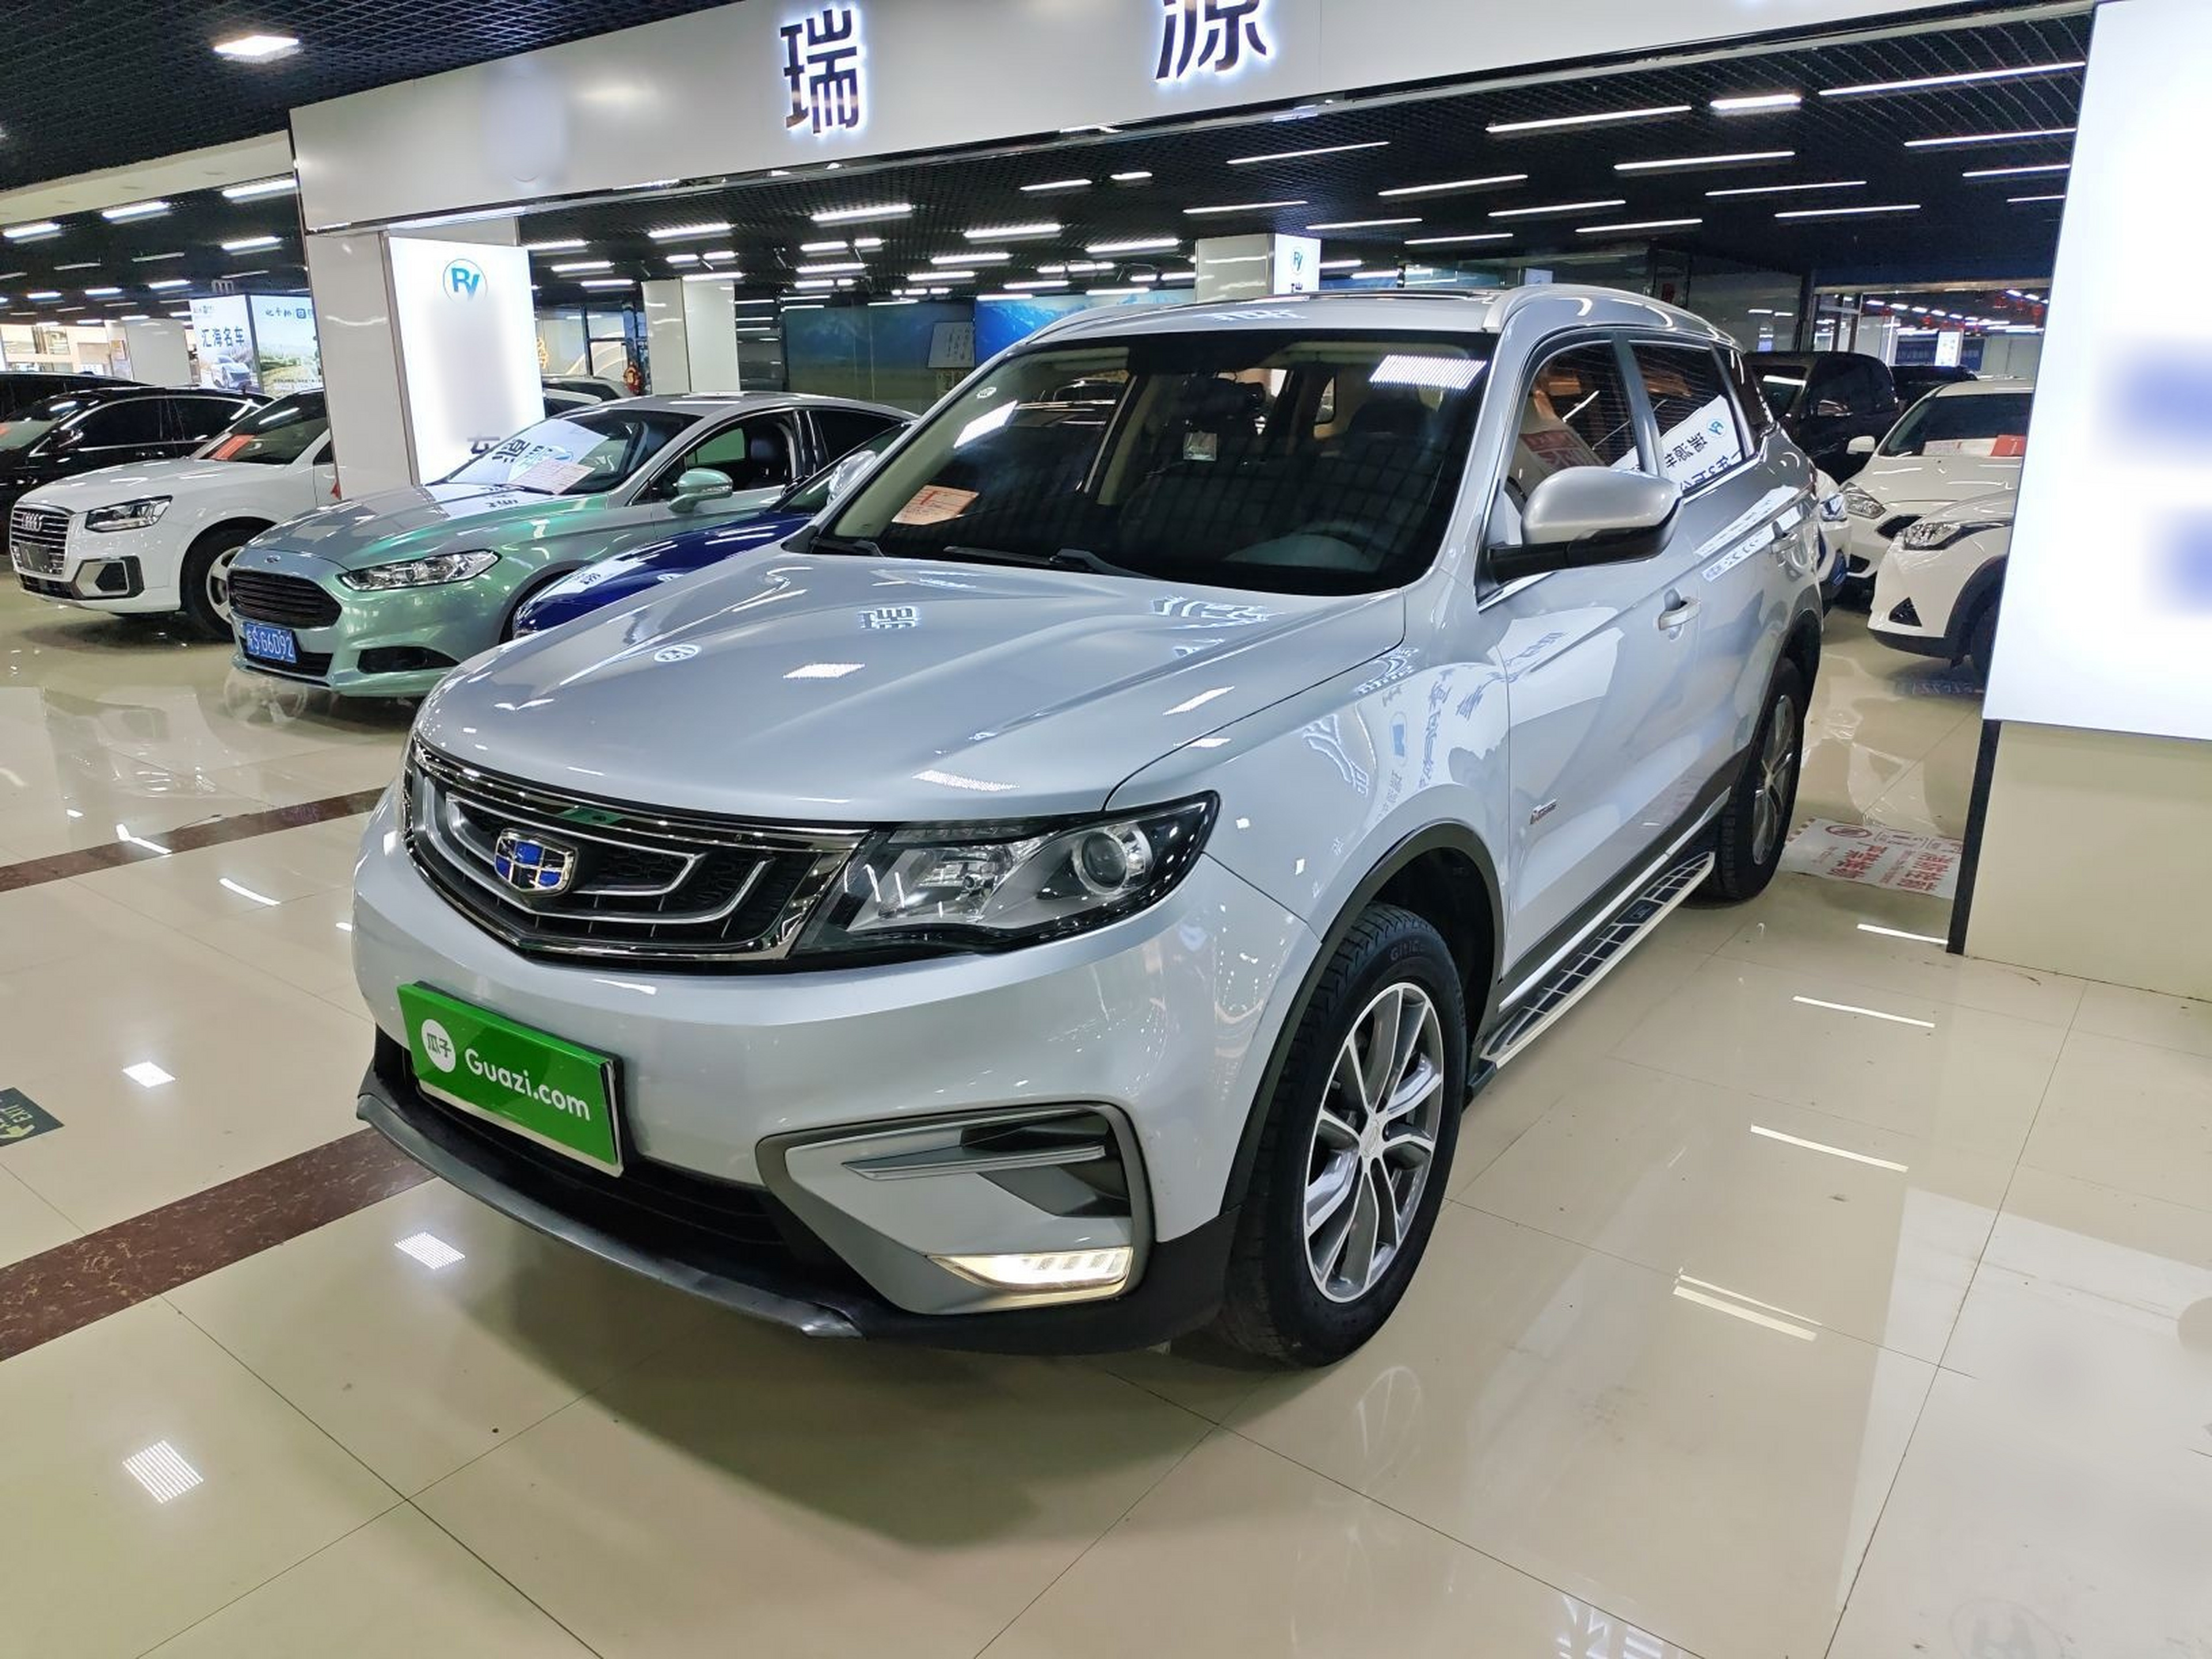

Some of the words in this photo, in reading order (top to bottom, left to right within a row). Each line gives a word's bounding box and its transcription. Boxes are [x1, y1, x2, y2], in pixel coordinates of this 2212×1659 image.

[781, 9, 859, 134] 瑞
[427, 1033, 451, 1058] 瓜子
[465, 1048, 590, 1121] Guazi.com
